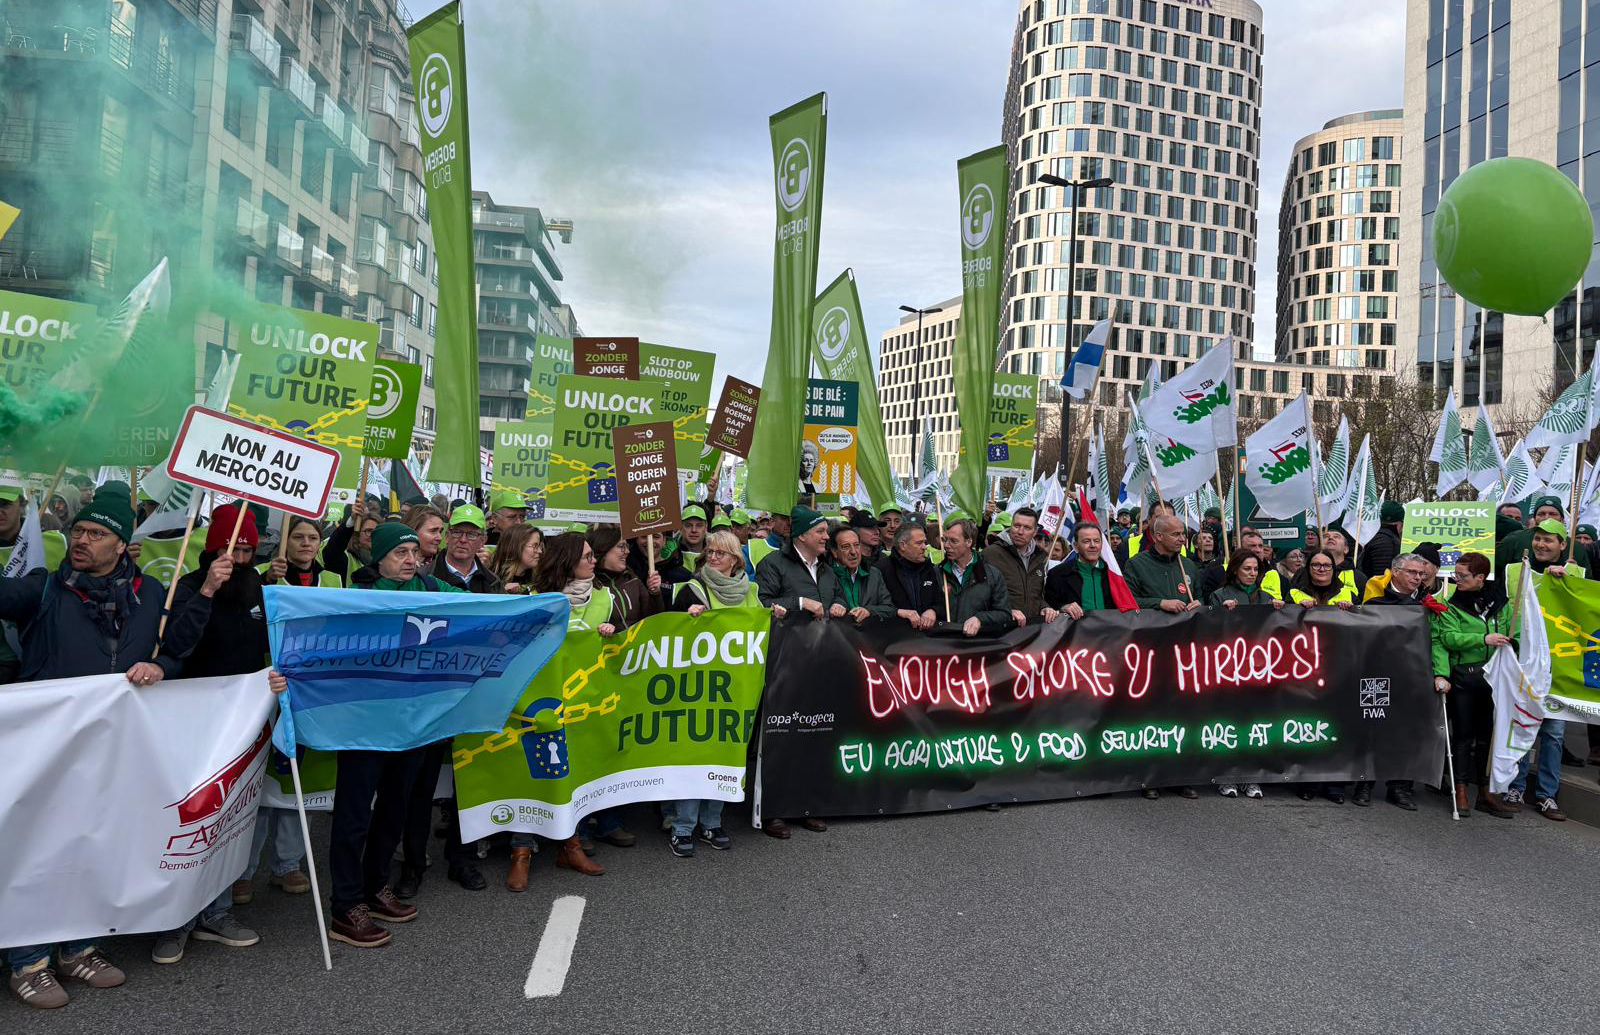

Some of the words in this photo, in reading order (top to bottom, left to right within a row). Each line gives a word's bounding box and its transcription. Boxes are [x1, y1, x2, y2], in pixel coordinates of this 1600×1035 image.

[0, 311, 80, 342] LOCK
[250, 322, 369, 362] UNLOCK
[2, 338, 46, 364] UR
[540, 344, 574, 363] UNL
[584, 353, 629, 363] ZONDER
[275, 353, 337, 382] OUR
[588, 365, 625, 375] JONGE
[649, 355, 676, 369] SLOT
[678, 359, 693, 370] OP
[639, 365, 700, 382] LANDBOUW
[246, 373, 357, 411] FUTURE
[672, 391, 688, 401] OP
[729, 388, 758, 407] ZONDER
[812, 387, 824, 400] DE
[825, 385, 841, 401] BLÉ
[993, 382, 1033, 399] LOCK
[564, 389, 654, 415] UNLOCK
[728, 400, 754, 414] JONGE
[724, 406, 753, 423] BOEREN
[812, 404, 823, 417] DE
[825, 404, 845, 418] PAIN
[990, 411, 1029, 426] TURE
[725, 417, 746, 430] GAAT
[725, 426, 741, 436] HET
[363, 426, 396, 439] EREN
[500, 432, 553, 448] UNLO
[220, 433, 267, 462] NON
[269, 452, 301, 472] AU
[624, 440, 665, 453] ZONDER
[629, 453, 664, 468] JONGE
[195, 449, 309, 500] MERCOSUR
[501, 463, 549, 478] FUTU
[627, 466, 667, 482] BOEREN
[634, 481, 662, 495] GAAT
[640, 495, 660, 507] HET
[1411, 508, 1489, 518] UNLOCK
[1428, 517, 1470, 527] OUR
[1411, 526, 1486, 538] FUTURE
[620, 630, 767, 676] UNLOCK
[859, 650, 992, 718] ENOUGH
[1006, 647, 1114, 700] SMOKE
[1173, 625, 1325, 694] MIRRORS!
[646, 669, 733, 706] OUR
[1363, 708, 1386, 719] FWA
[839, 743, 873, 773] EU
[1038, 732, 1087, 760] FOOD
[1200, 722, 1238, 750] ARE
[1248, 723, 1273, 746] AT
[1282, 719, 1338, 744] RISK.
[707, 771, 738, 783] Groene
[589, 786, 607, 800] voor
[606, 776, 665, 795] agravrouwen
[717, 782, 738, 795] Kring
[518, 805, 554, 820] BOEREN
[519, 814, 544, 827] BOND
[159, 858, 199, 870] Demain
